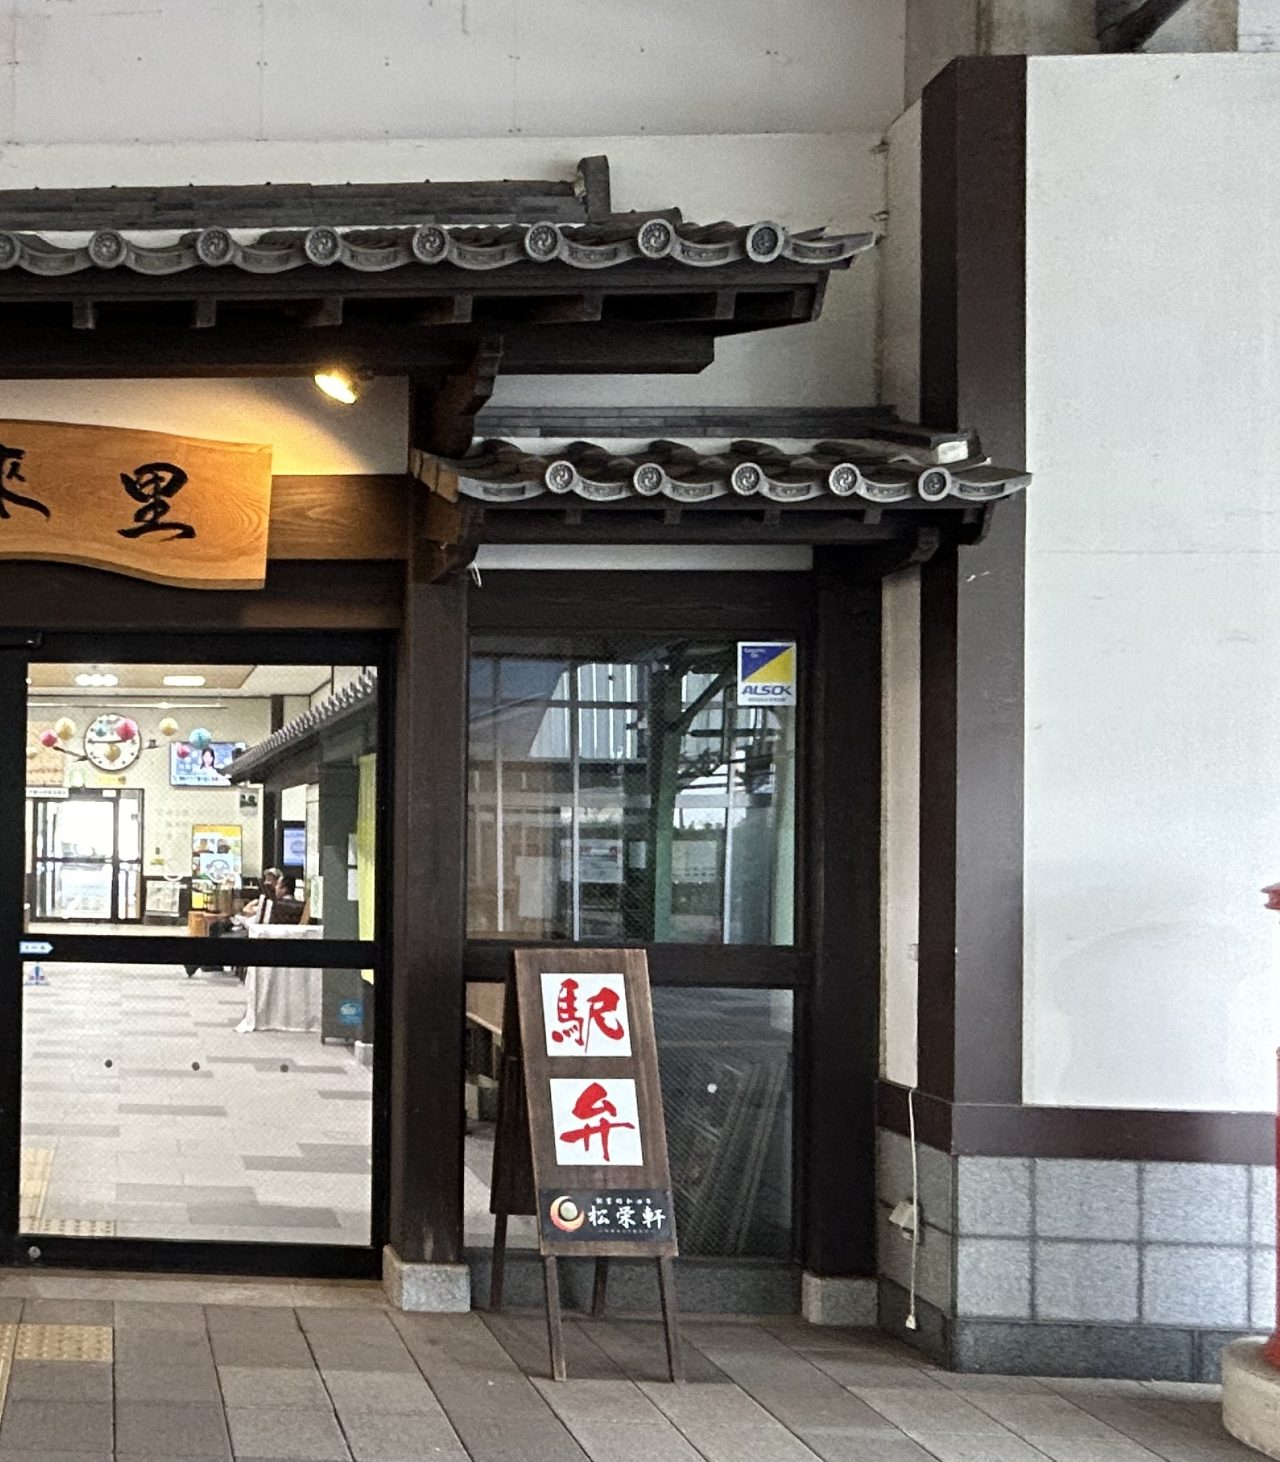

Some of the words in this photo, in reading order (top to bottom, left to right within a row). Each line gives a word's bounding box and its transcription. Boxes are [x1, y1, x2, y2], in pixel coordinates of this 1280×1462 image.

[741, 685, 793, 696] ALSOK
[552, 978, 636, 1163] 駅弁
[587, 1205, 667, 1229] 松栄軒
